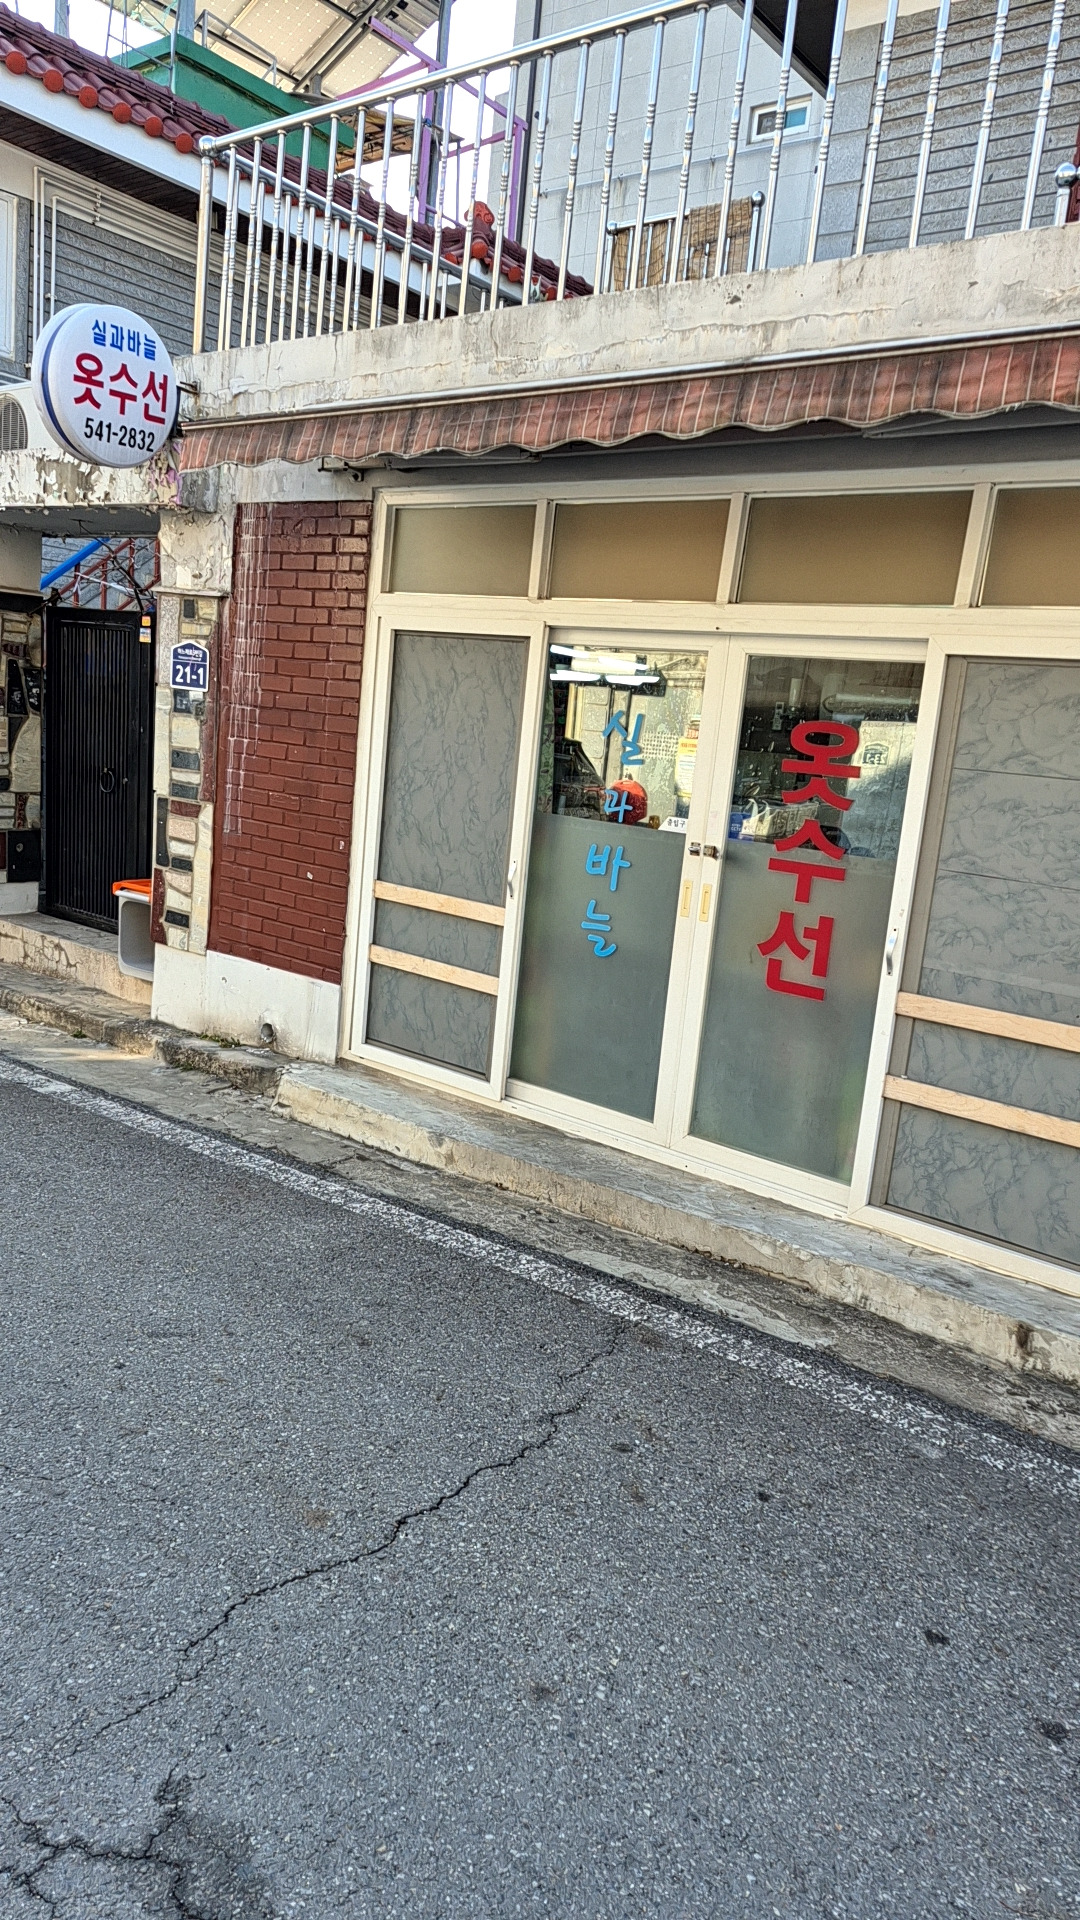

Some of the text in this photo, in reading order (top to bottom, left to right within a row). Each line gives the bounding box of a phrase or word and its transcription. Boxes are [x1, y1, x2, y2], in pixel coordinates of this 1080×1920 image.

[92, 319, 157, 361] 실과바늘
[73, 352, 168, 424] 옷수선
[84, 417, 155, 452] 541-2832
[175, 664, 204, 686] 21-1
